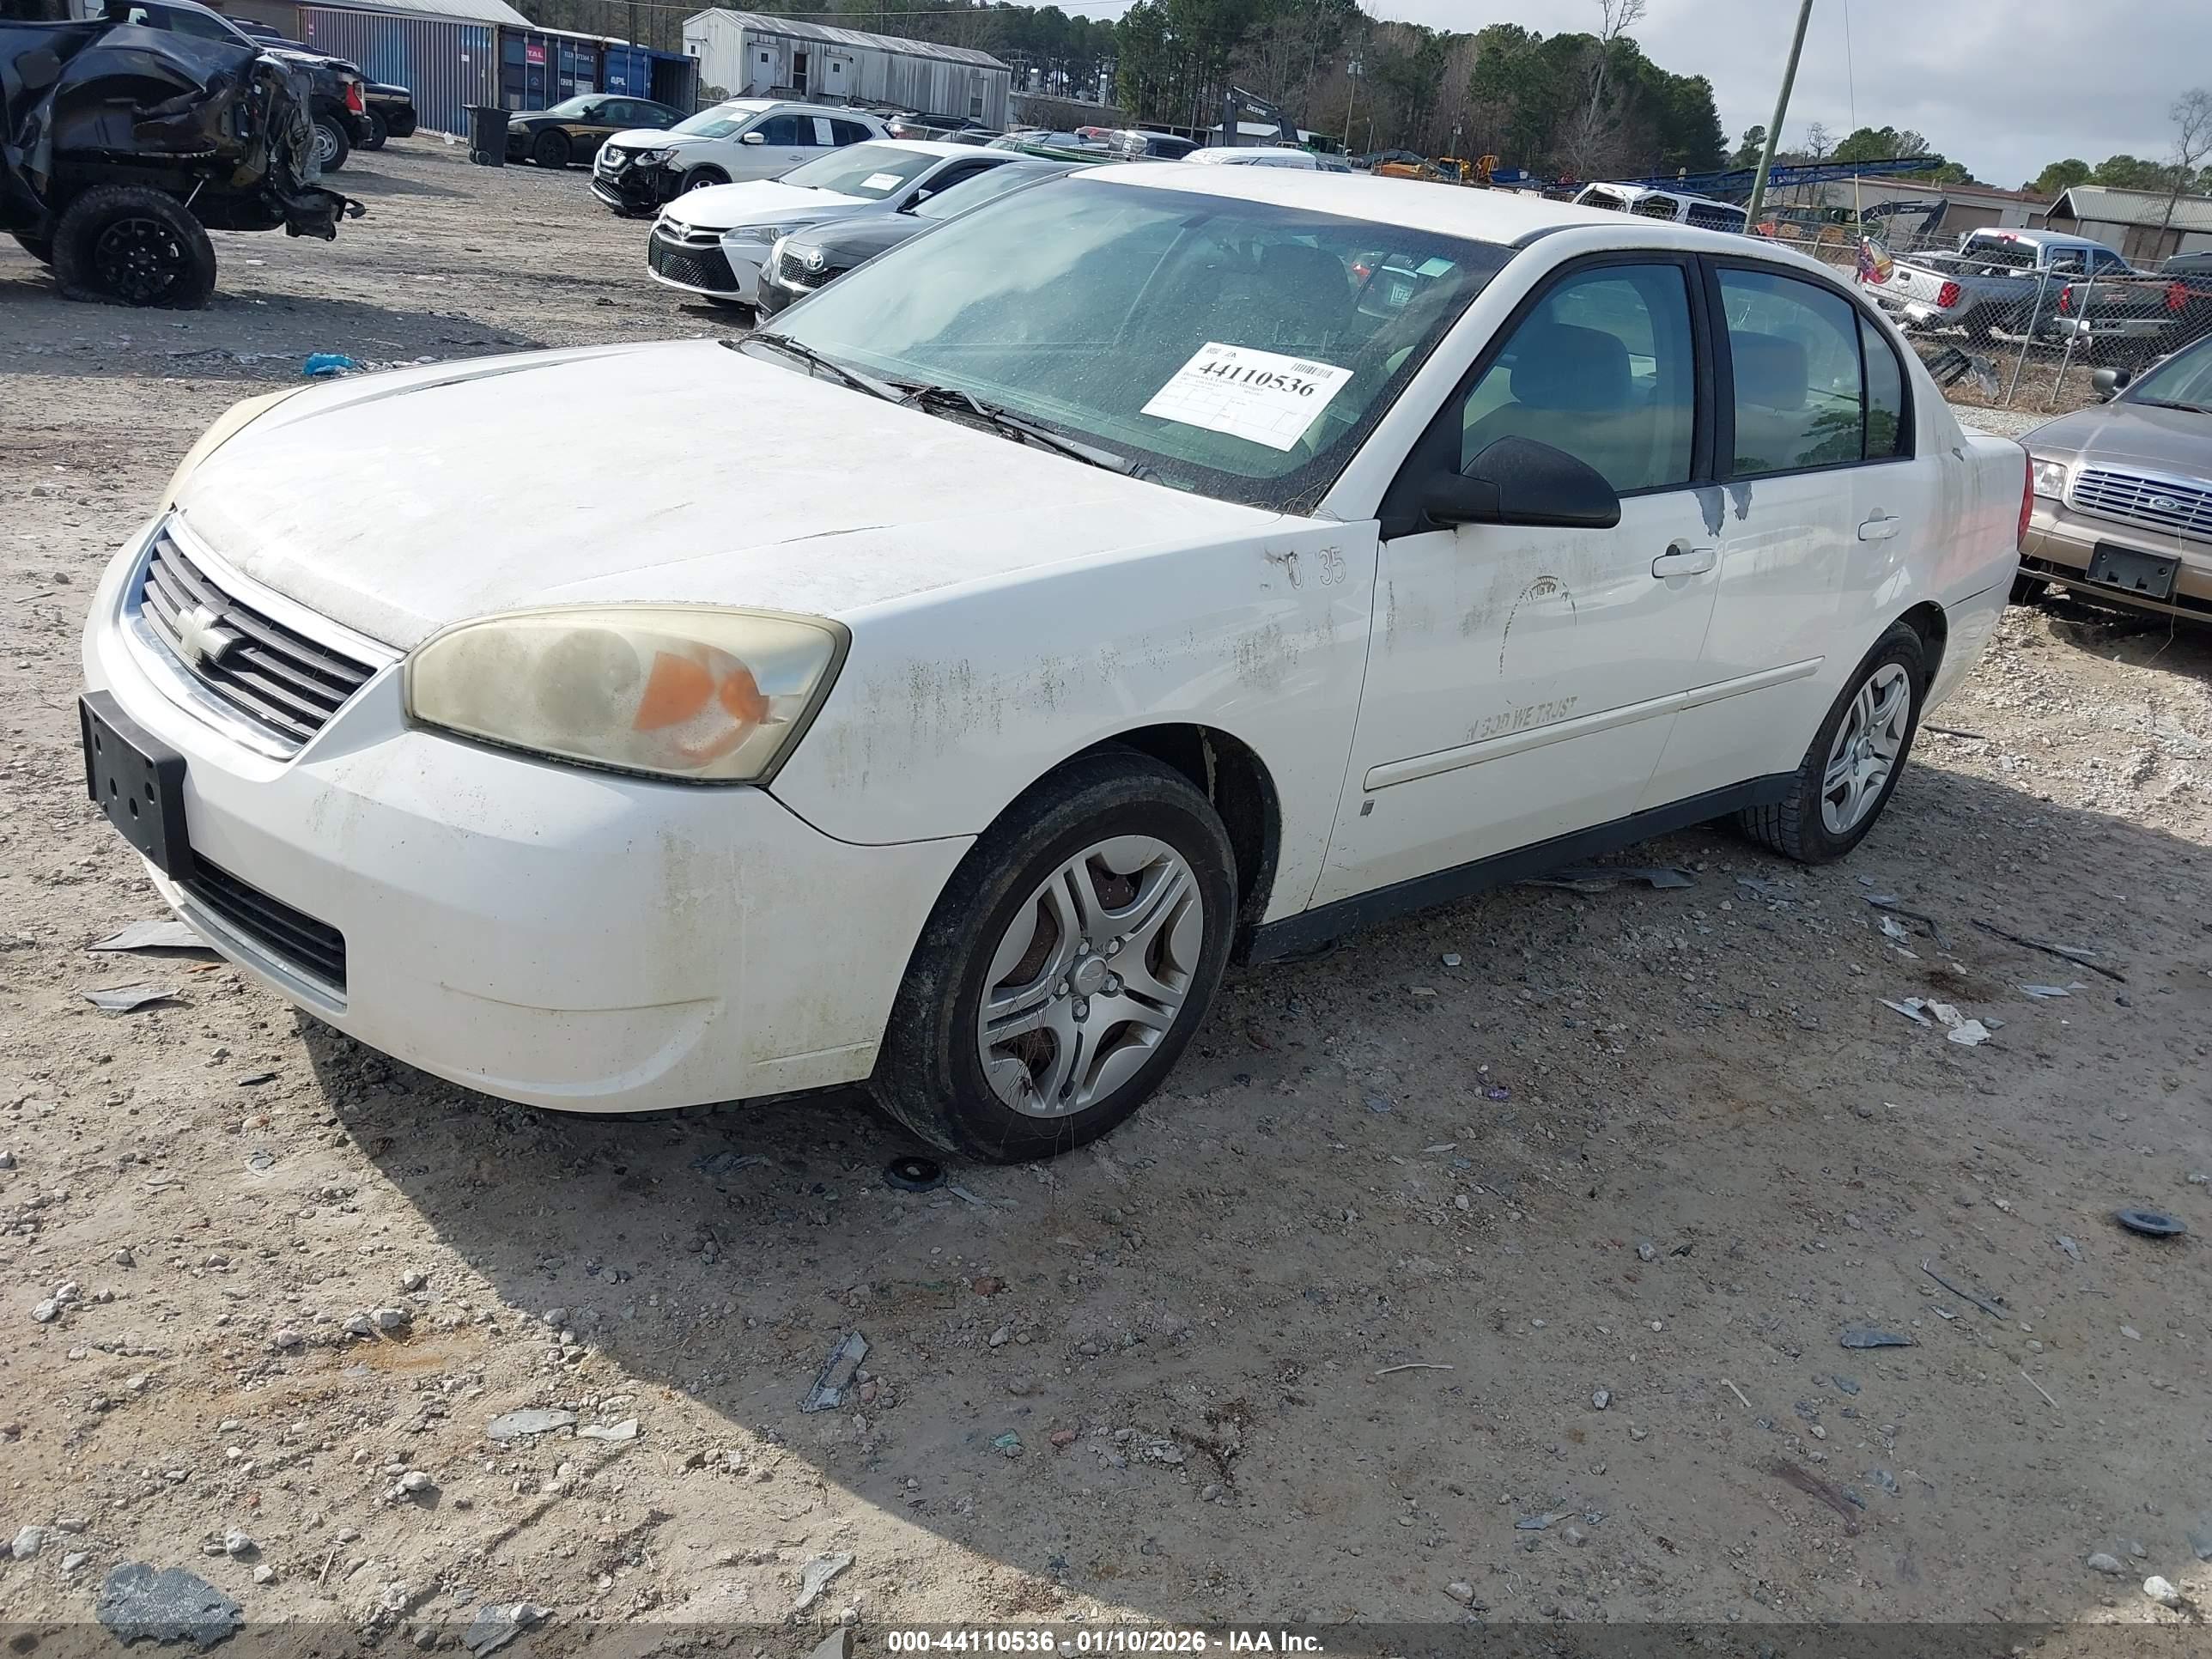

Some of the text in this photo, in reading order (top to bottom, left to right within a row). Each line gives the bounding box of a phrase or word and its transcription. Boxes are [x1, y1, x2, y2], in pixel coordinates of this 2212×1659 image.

[527, 50, 543, 58] TAL
[611, 76, 626, 85] APL
[1246, 104, 1267, 117] DEERE
[1199, 361, 1321, 398] 44110536
[1318, 546, 1346, 586] 35
[1511, 706, 1534, 730] WE
[1536, 696, 1578, 725] TRUST
